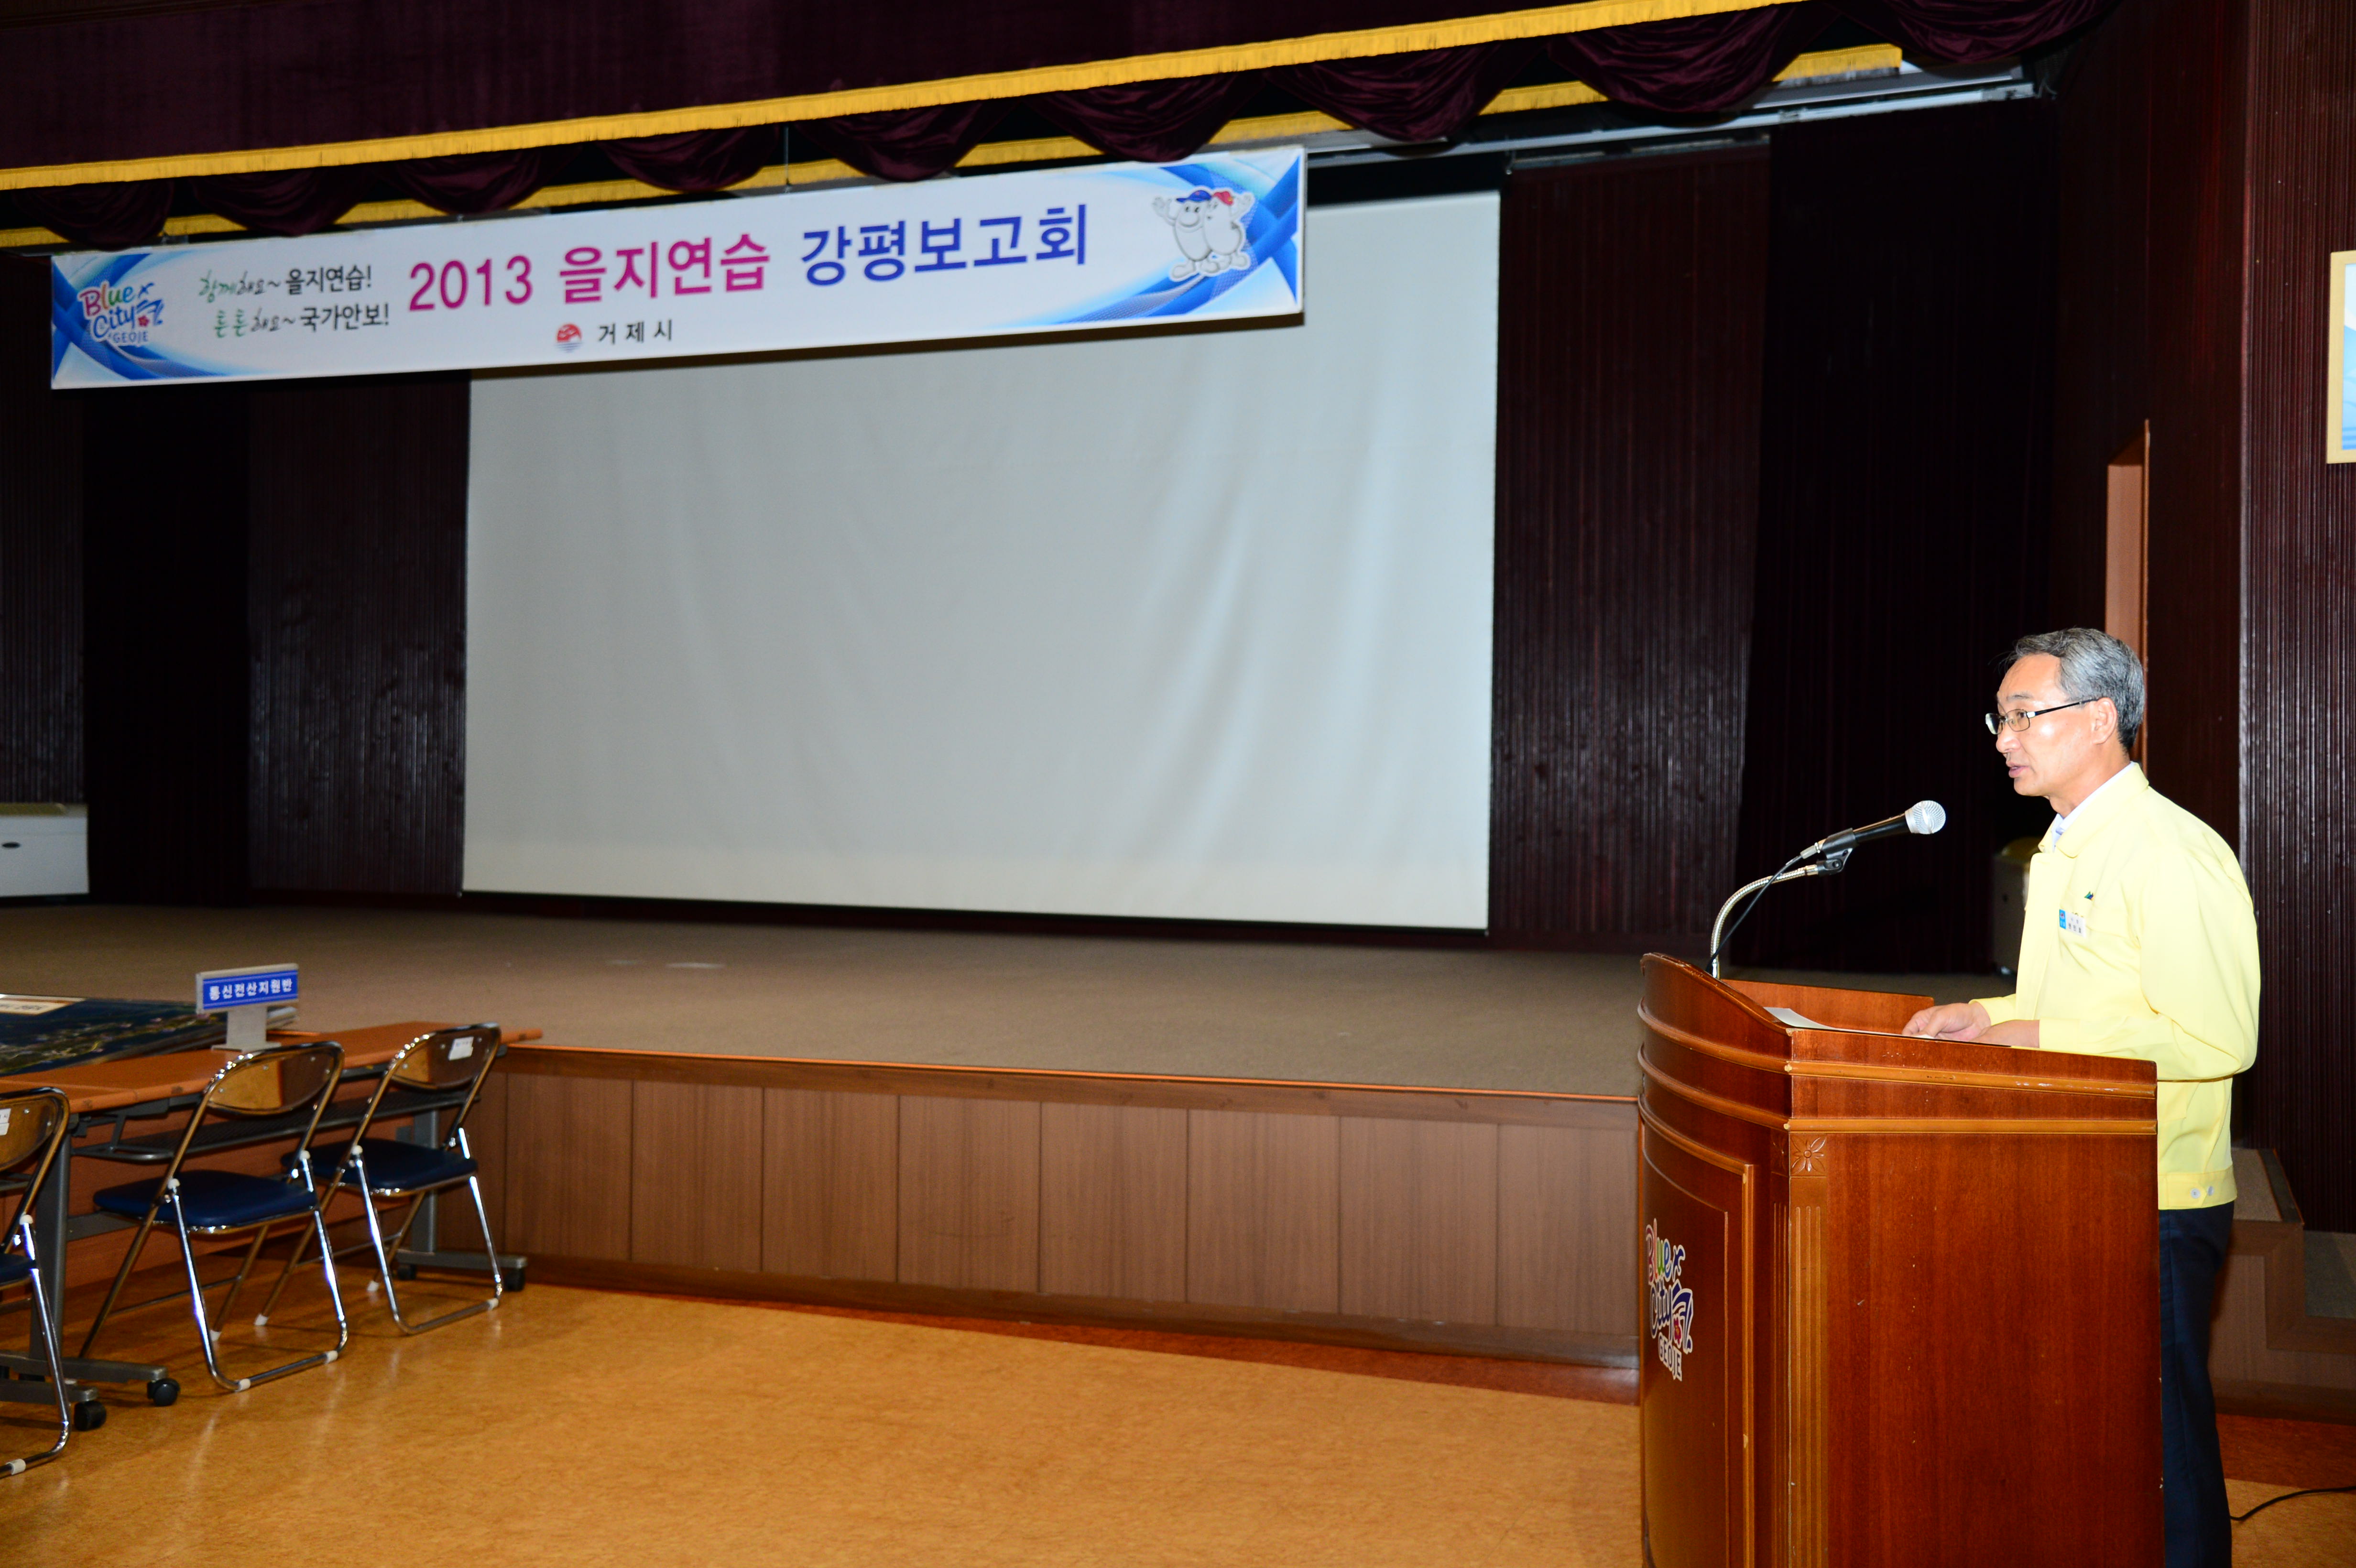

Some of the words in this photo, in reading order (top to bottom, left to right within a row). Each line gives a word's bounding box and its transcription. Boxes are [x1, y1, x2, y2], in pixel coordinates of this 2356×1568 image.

[408, 255, 534, 312] 2013
[559, 233, 771, 304] 을지연습
[802, 204, 1086, 286] 강평보고회
[286, 265, 372, 295] 을지연습!
[79, 283, 136, 316] Blue
[93, 306, 136, 338] City
[300, 304, 389, 332] 국가안보!
[112, 331, 149, 343] GEOJE
[209, 978, 292, 1001] 통신전산지원반
[1646, 1219, 1672, 1285] Blue
[1650, 1280, 1673, 1342] City
[1658, 1332, 1682, 1381] GEOJE
